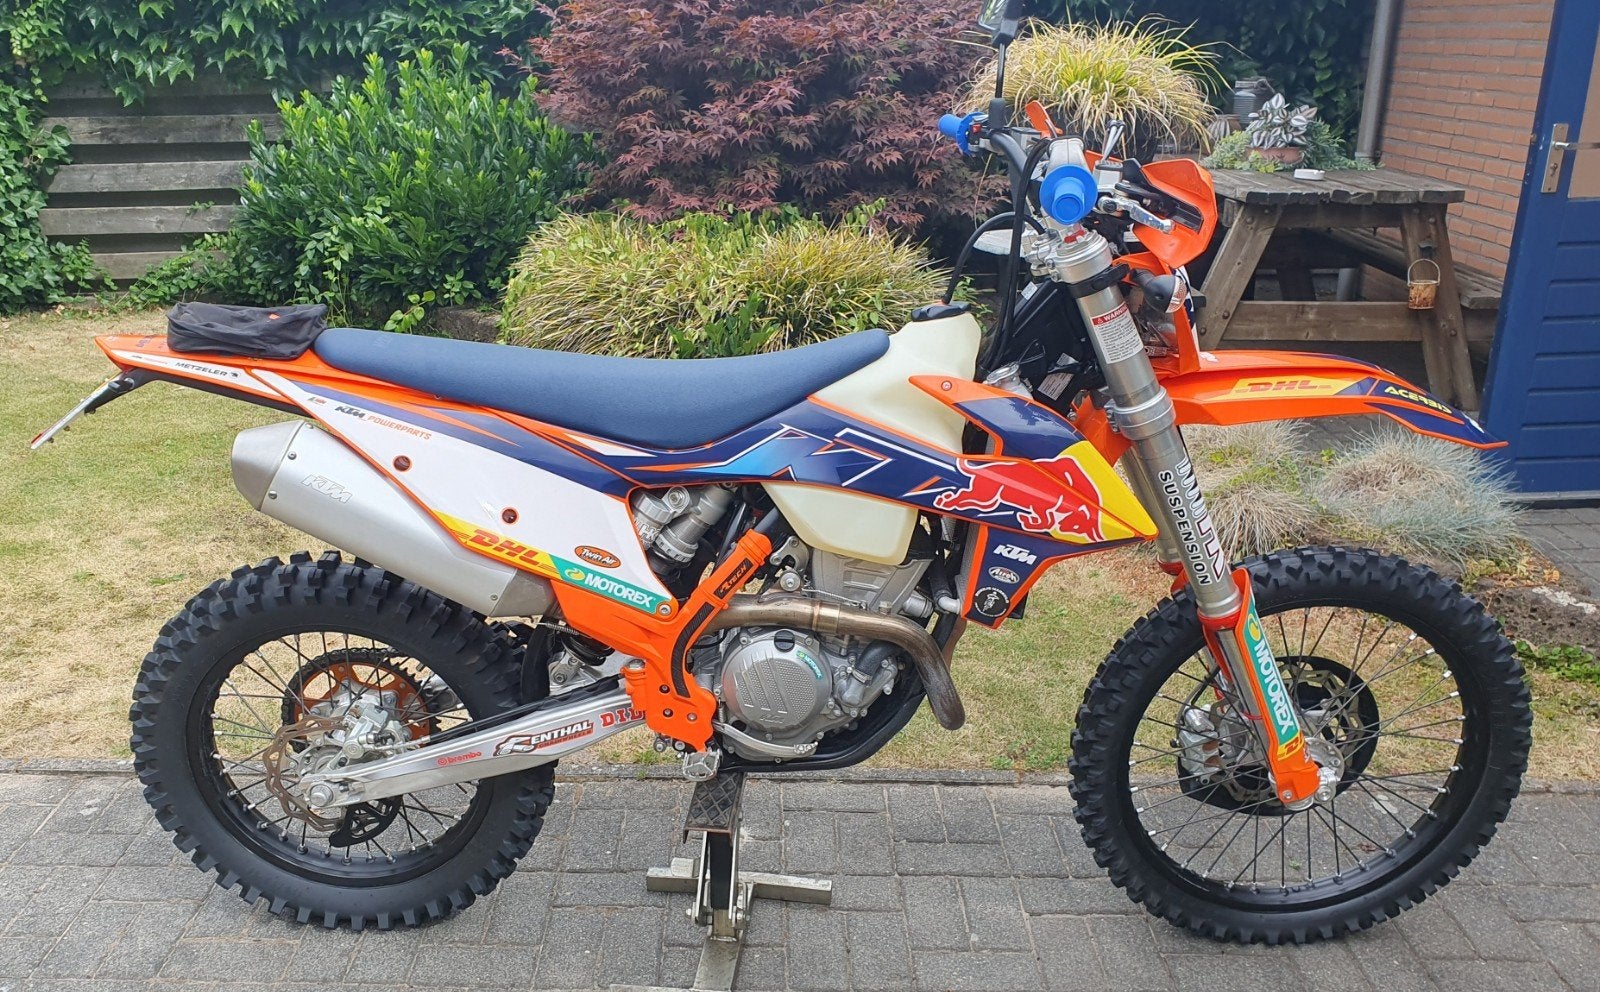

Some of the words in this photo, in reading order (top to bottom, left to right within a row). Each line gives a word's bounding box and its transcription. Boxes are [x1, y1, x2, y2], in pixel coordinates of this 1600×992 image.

[175, 361, 228, 377] METZELER
[1247, 380, 1318, 392] DHL
[1384, 385, 1452, 414] ACERBIS
[334, 405, 366, 419] KTM
[367, 415, 432, 441] POWERPARTS
[300, 474, 353, 504] KTM
[1159, 470, 1211, 585] SUSPENSION
[468, 529, 540, 566] DHL
[580, 548, 602, 561] Twin
[600, 554, 616, 566] Air
[993, 544, 1038, 565] KTM
[584, 573, 652, 608] MOTOREX
[1254, 639, 1294, 735] MOTOREX
[447, 751, 482, 764] brembo
